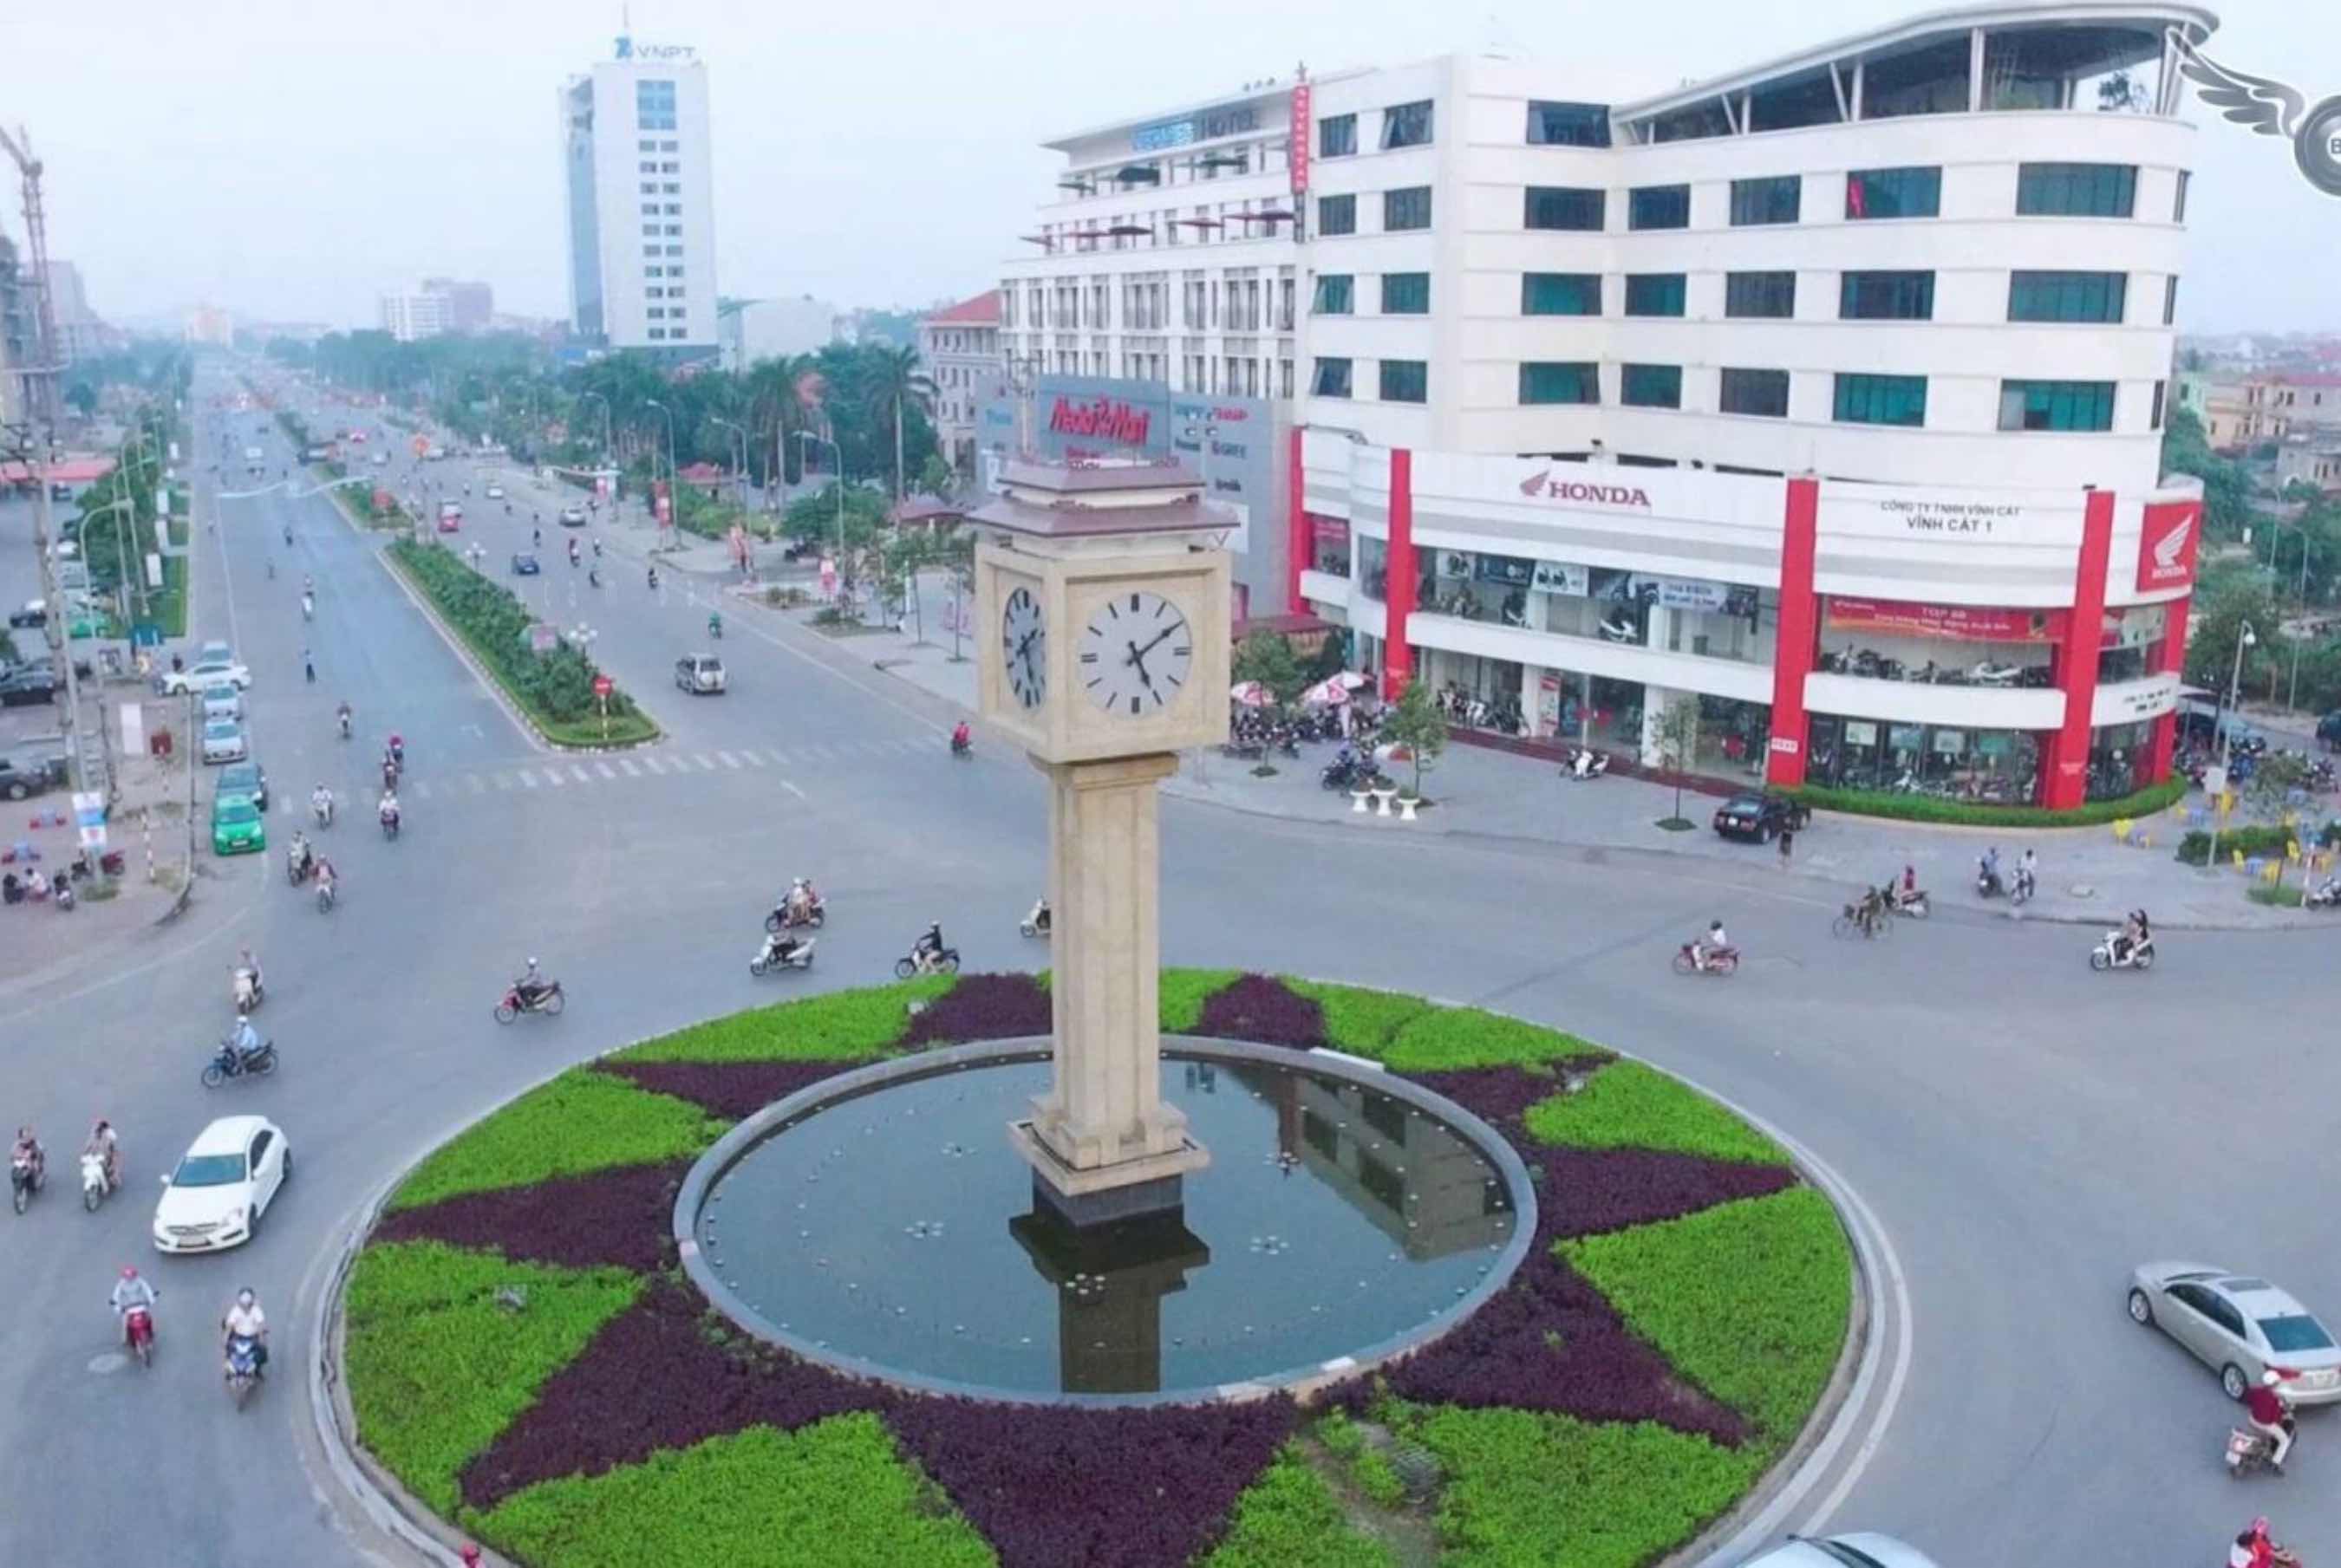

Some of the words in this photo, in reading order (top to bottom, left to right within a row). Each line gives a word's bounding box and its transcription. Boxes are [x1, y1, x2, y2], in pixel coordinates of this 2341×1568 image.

[637, 45, 696, 59] VNPT
[1549, 481, 1652, 507] HONDA
[1917, 502, 1931, 513] TY
[2151, 565, 2188, 579] HONDA
